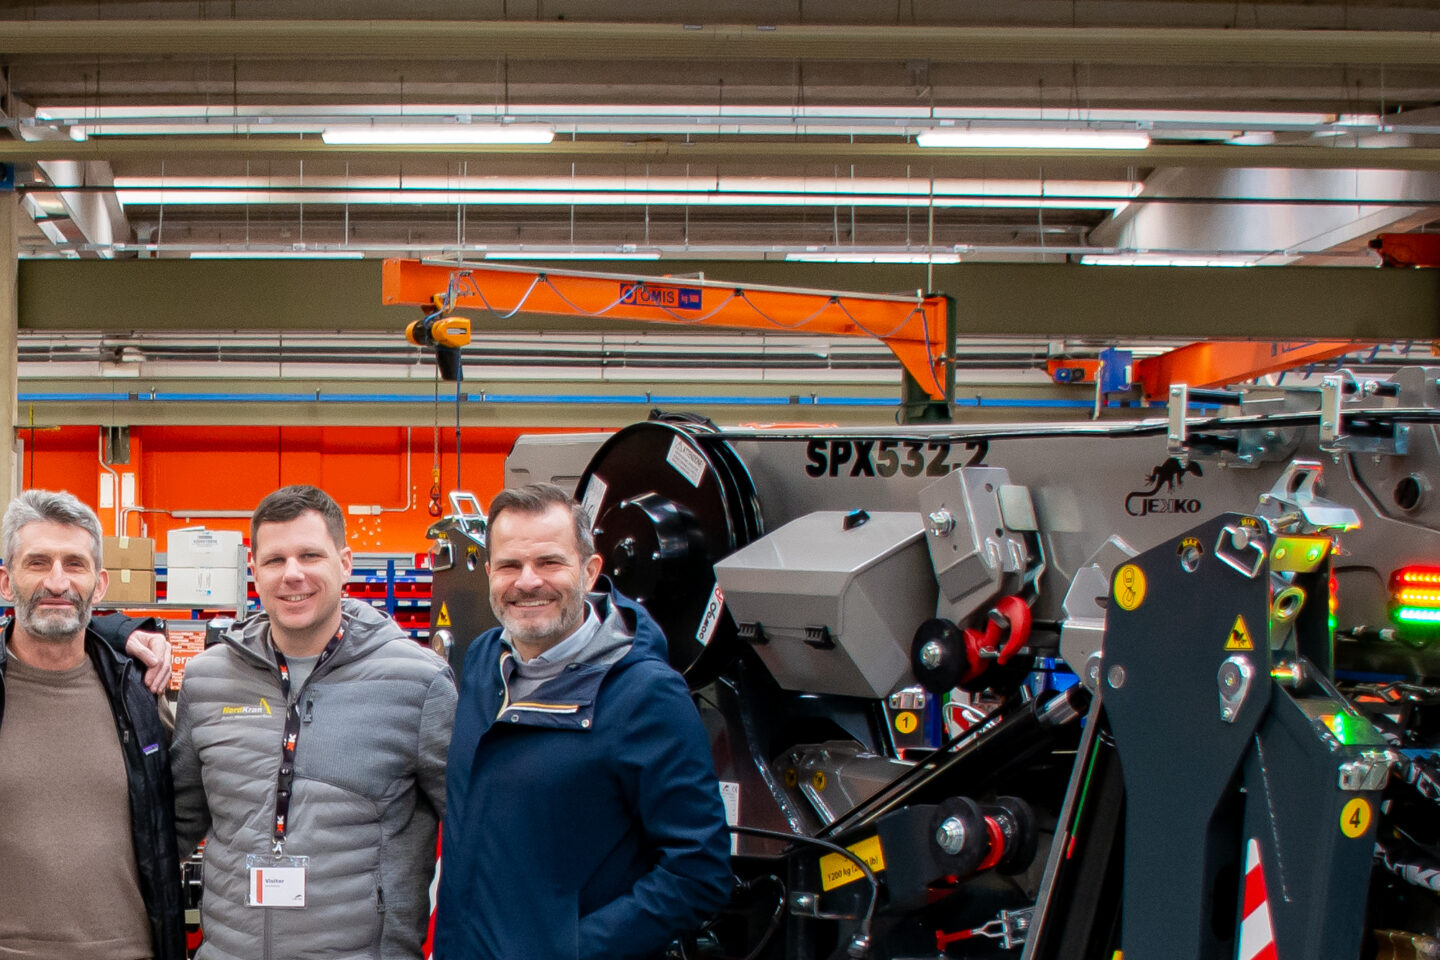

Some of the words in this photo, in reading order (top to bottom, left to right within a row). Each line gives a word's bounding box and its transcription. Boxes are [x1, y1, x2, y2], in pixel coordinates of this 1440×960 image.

[640, 288, 676, 304] OMIS
[805, 440, 990, 478] SPX532.2
[1140, 498, 1202, 516] JEKKO
[1349, 807, 1362, 829] 4
